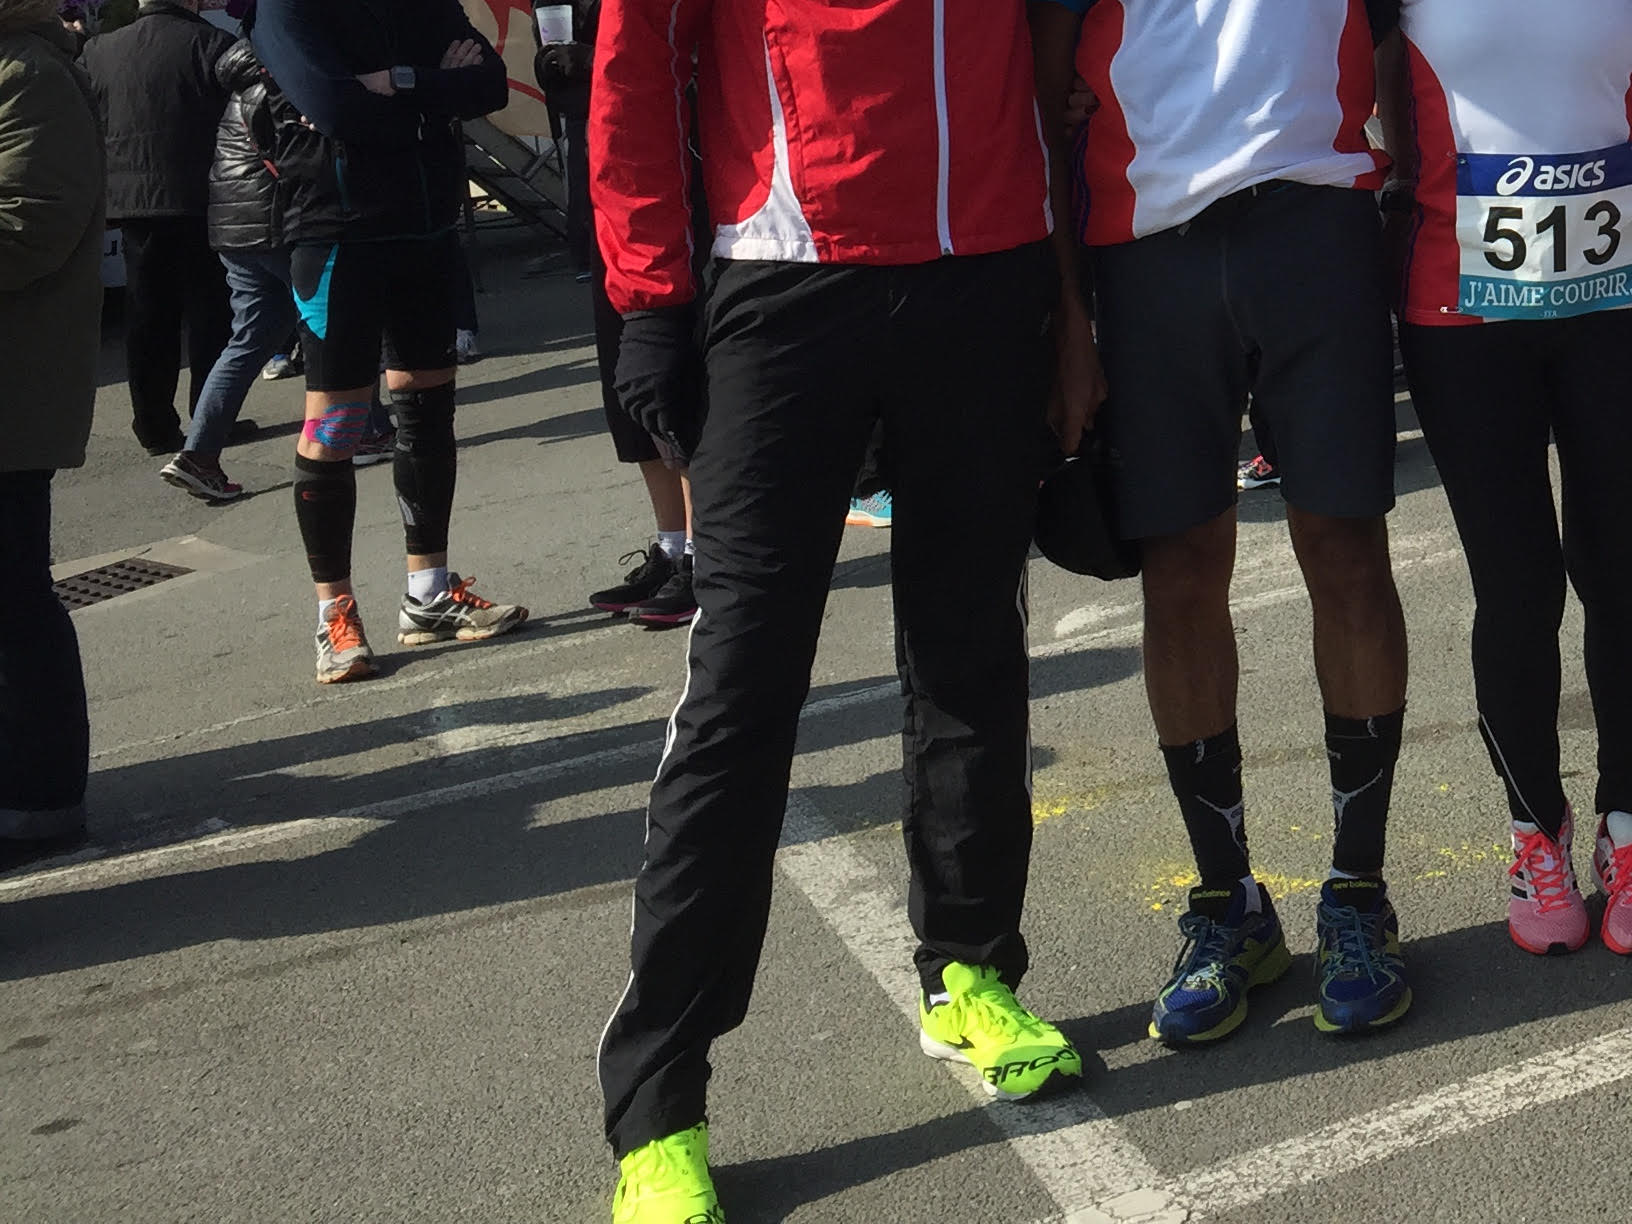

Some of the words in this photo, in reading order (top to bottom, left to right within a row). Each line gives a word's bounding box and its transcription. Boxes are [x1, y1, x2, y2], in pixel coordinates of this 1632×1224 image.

[1533, 160, 1607, 191] asics
[1483, 199, 1622, 273] 513
[1464, 280, 1545, 308] J'AIME
